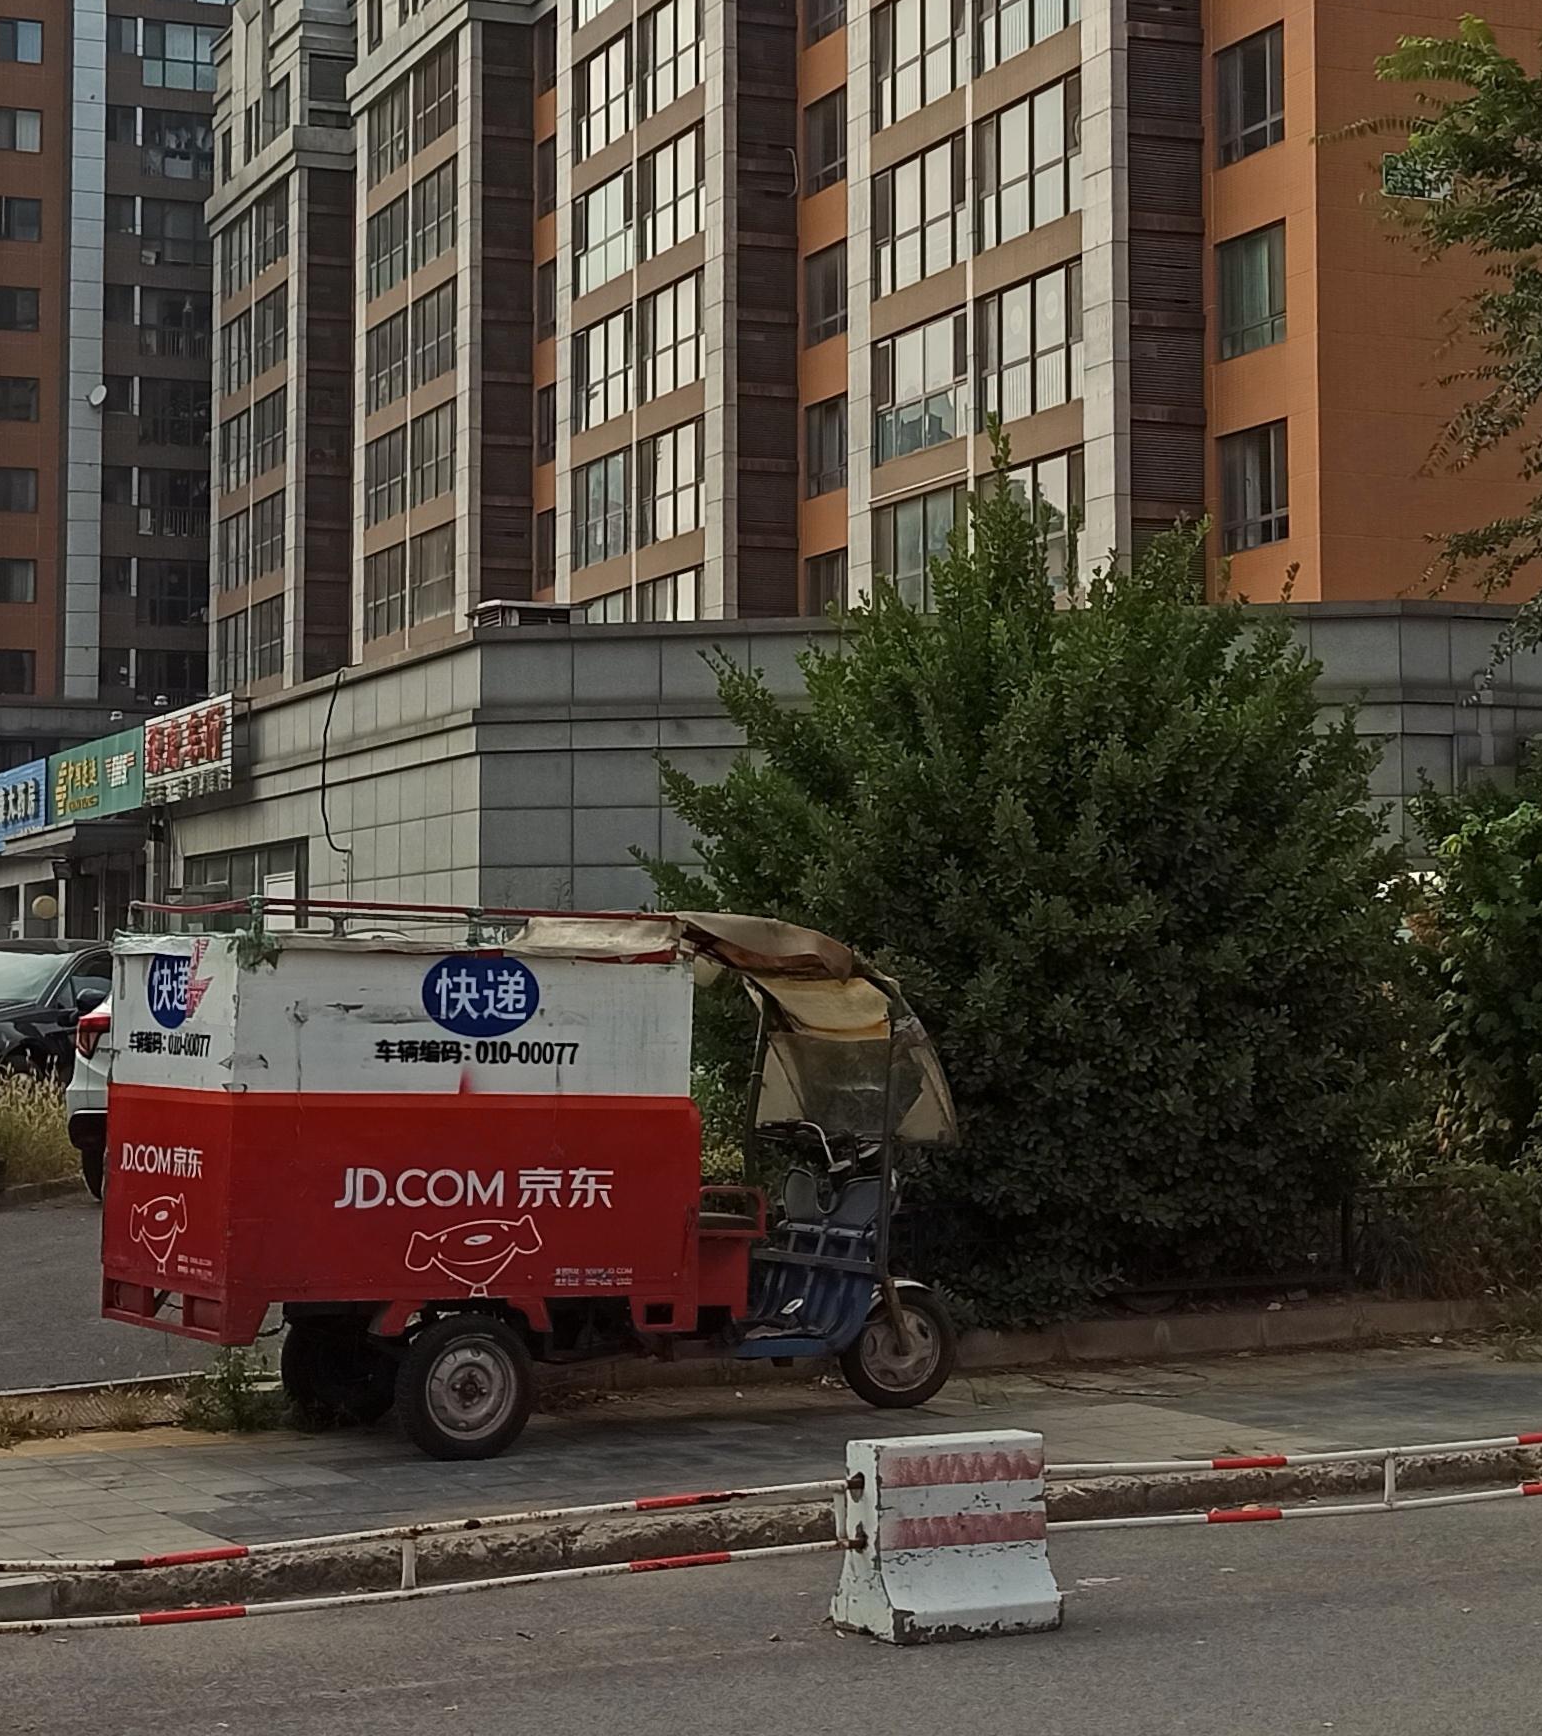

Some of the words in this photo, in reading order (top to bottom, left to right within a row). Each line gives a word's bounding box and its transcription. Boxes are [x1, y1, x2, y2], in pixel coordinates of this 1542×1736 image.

[435, 967, 527, 1020] 快递
[120, 1142, 171, 1176] JD.COM
[172, 1146, 203, 1179] 京东
[334, 1167, 504, 1209] JD.COM
[517, 1167, 614, 1209] 京东
